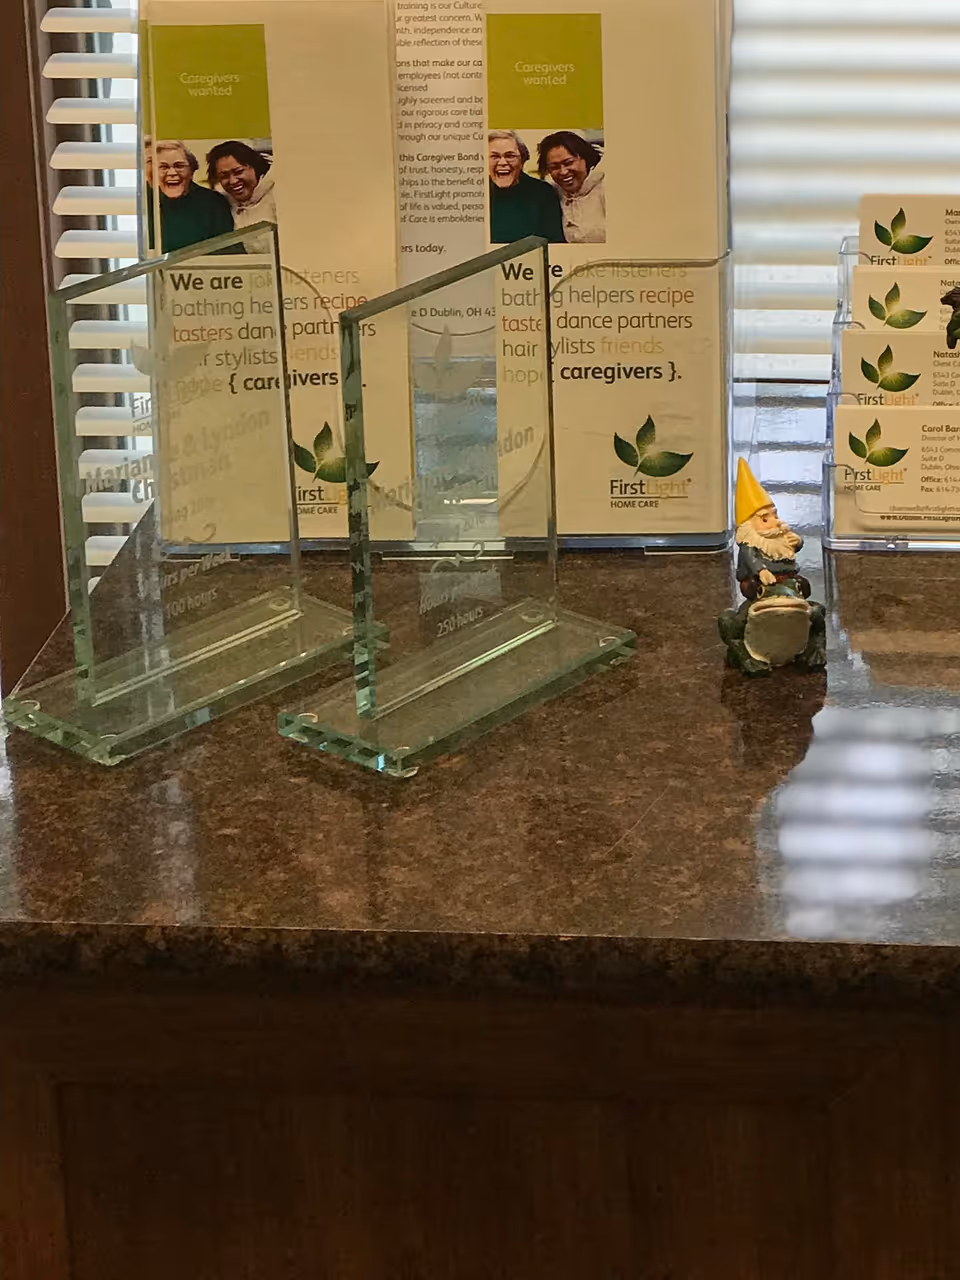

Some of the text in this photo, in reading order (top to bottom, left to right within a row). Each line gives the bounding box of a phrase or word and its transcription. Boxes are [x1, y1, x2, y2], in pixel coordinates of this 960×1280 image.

[514, 60, 576, 77] Caregivers
[179, 72, 240, 88] Caregivers
[523, 74, 567, 86] wanted
[188, 84, 233, 97] wanted
[399, 152, 479, 164] this Caregiver Bond
[415, 243, 447, 255] today.
[501, 262, 534, 281] We
[169, 272, 243, 292] We are
[313, 293, 368, 311] recipe
[569, 284, 695, 308] helpers recipe
[171, 298, 244, 319] bathing
[419, 307, 482, 318] D Dublin, OH
[556, 311, 693, 334] dance partners
[173, 325, 233, 344] tasters
[502, 339, 539, 357] hair
[600, 336, 665, 354] friends
[215, 347, 278, 370] stylists
[559, 360, 683, 385] caregivers }.
[922, 424, 944, 432] Carol
[609, 478, 689, 500] FirstLight
[610, 500, 660, 508] HOME CARE
